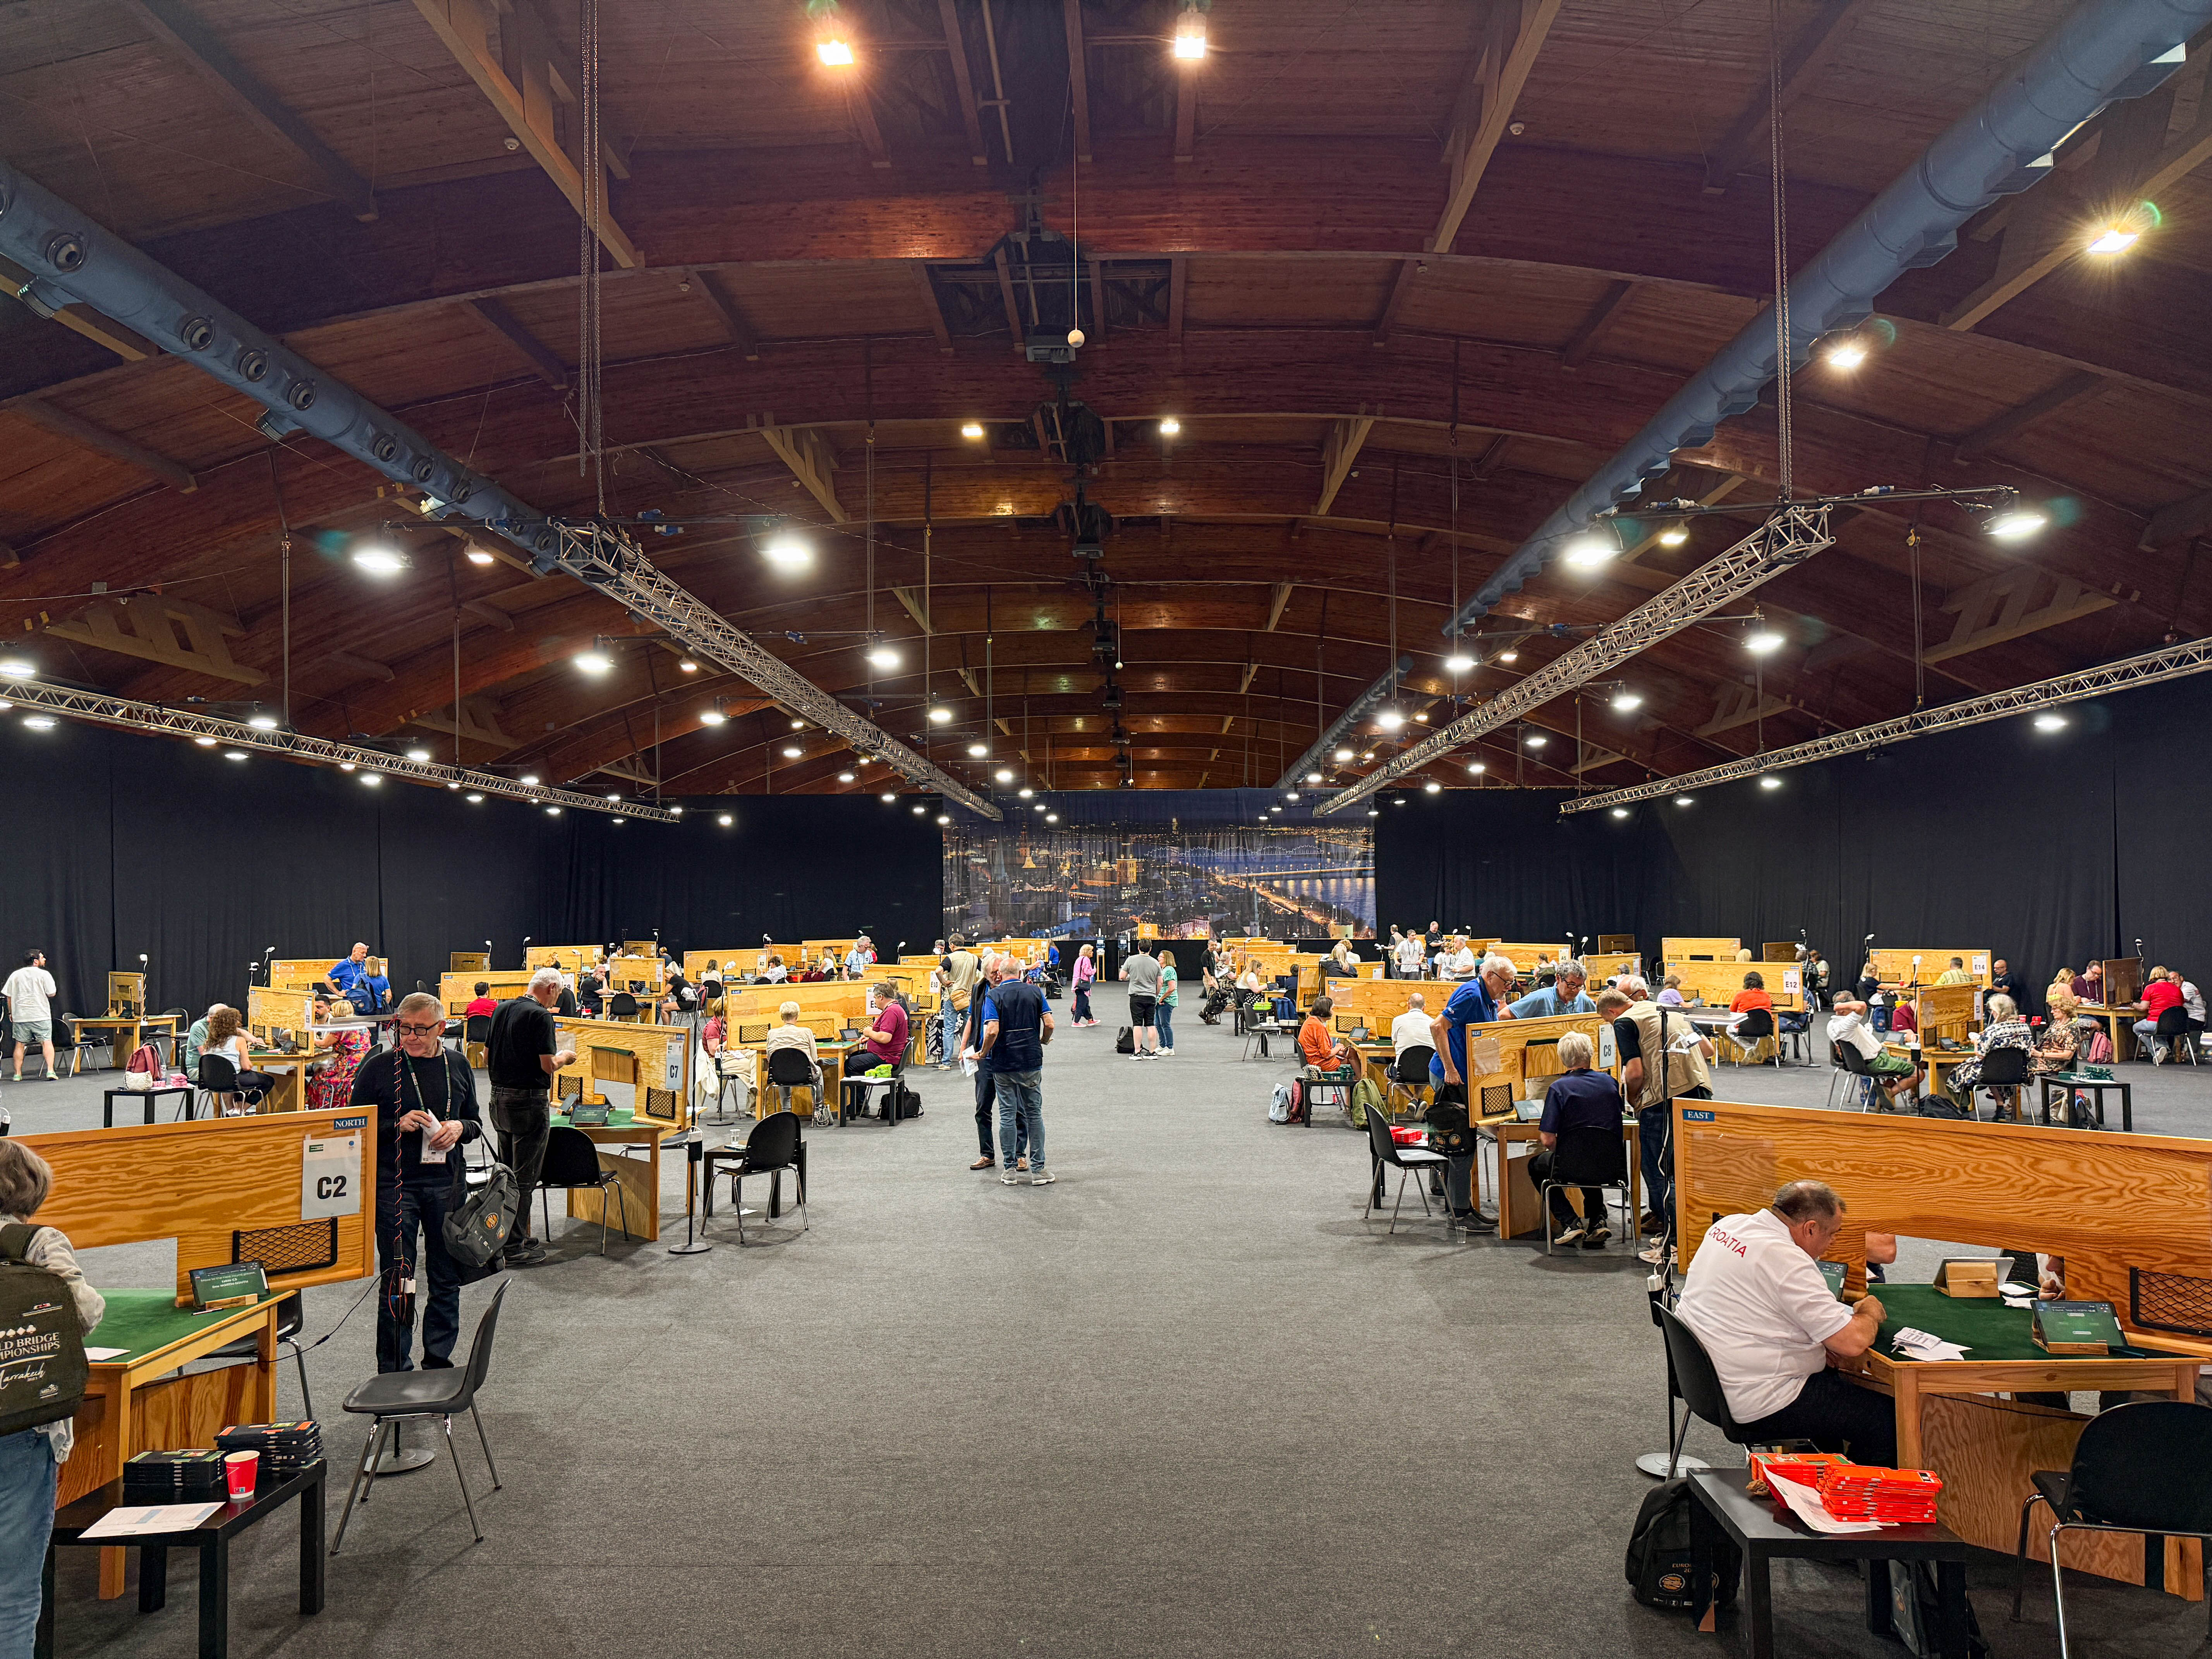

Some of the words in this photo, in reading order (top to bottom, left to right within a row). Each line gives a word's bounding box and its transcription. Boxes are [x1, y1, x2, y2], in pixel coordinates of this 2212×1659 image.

[1604, 1044, 1611, 1057] C8
[670, 1065, 679, 1079] C7
[1688, 1111, 1710, 1119] EAST
[335, 1118, 365, 1128] NORTH
[317, 1175, 347, 1199] C2
[1709, 1226, 1747, 1258] CROATIA
[17, 1332, 60, 1348] BRIDGE
